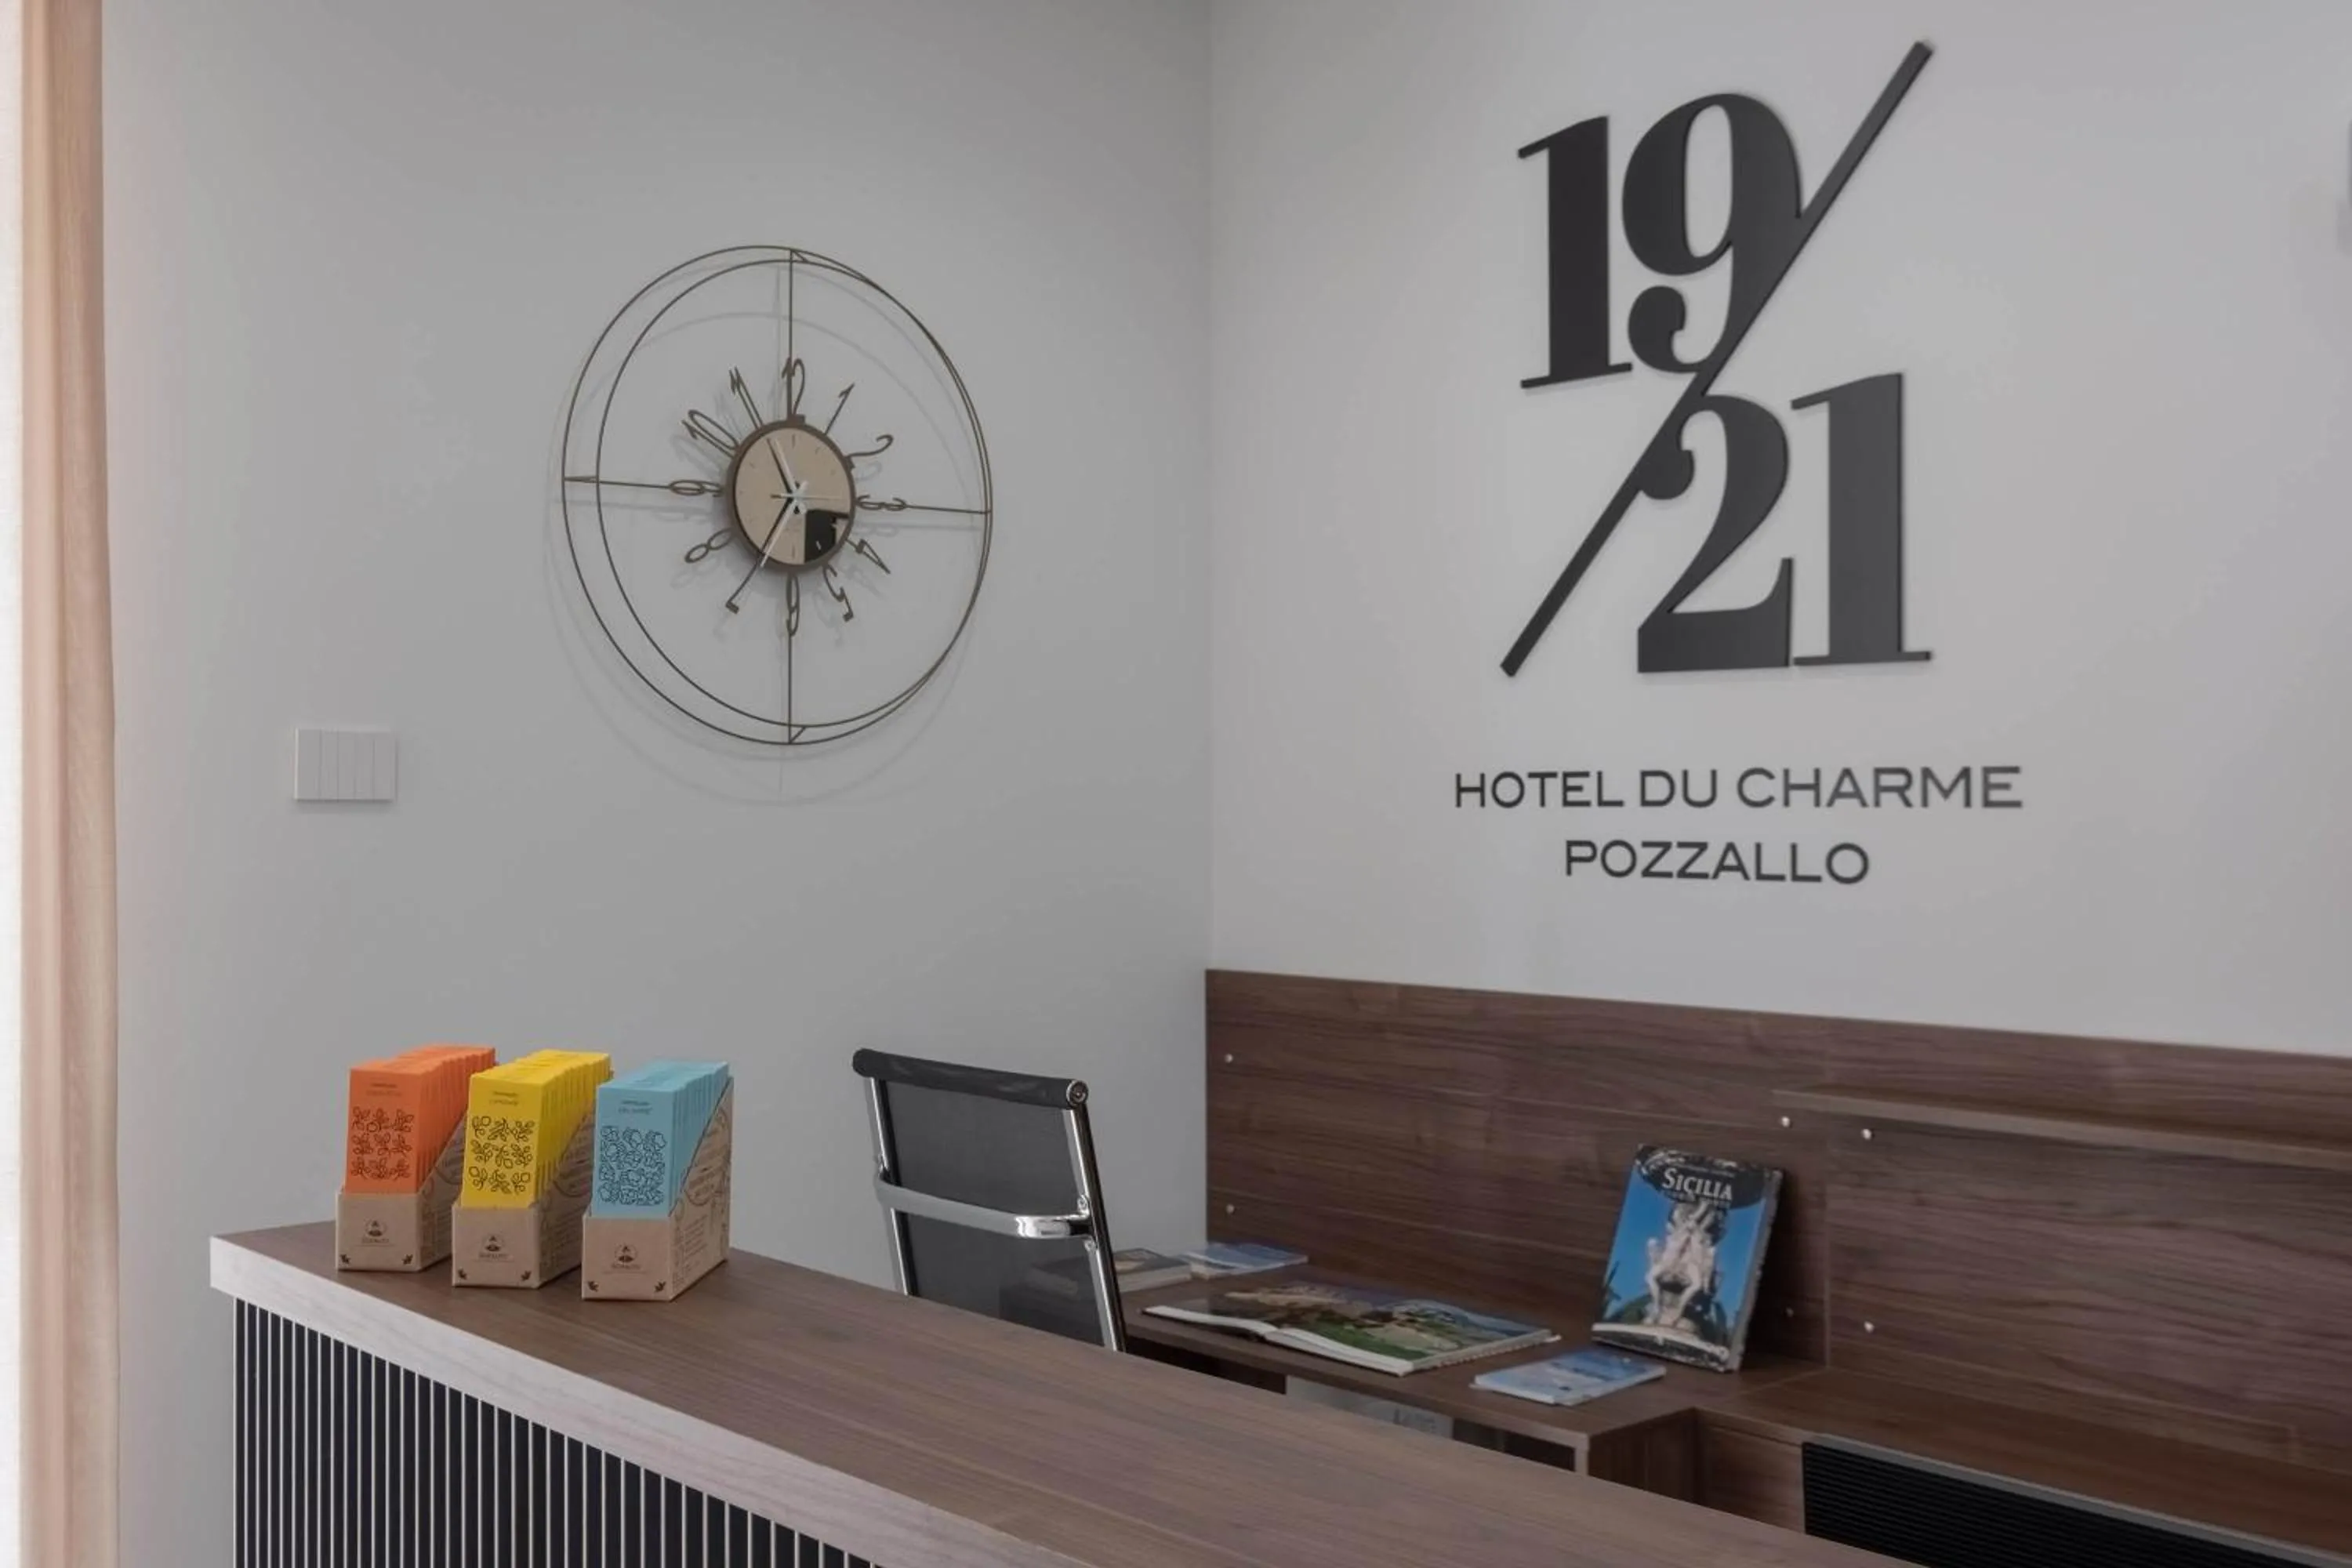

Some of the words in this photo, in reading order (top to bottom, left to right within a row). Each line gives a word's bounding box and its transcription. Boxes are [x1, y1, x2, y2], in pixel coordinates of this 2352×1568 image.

[1456, 771, 1624, 808] HOTEL
[1640, 770, 1718, 808] DU
[1737, 766, 2023, 809] CHARME
[1566, 840, 1870, 884] POZZALLO
